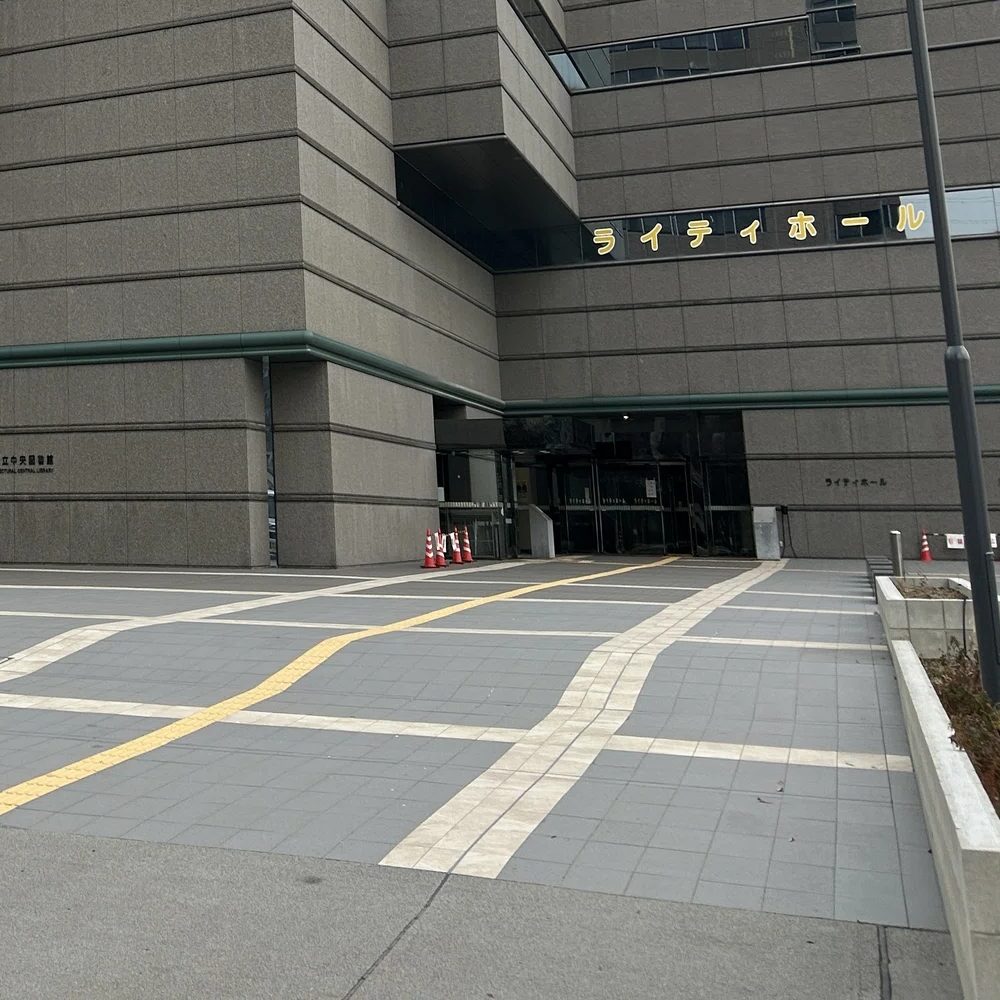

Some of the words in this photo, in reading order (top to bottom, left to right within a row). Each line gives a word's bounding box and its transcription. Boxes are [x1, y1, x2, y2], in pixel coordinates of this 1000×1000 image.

[593, 203, 925, 255] ライティホール
[825, 478, 887, 487] ライティホール
